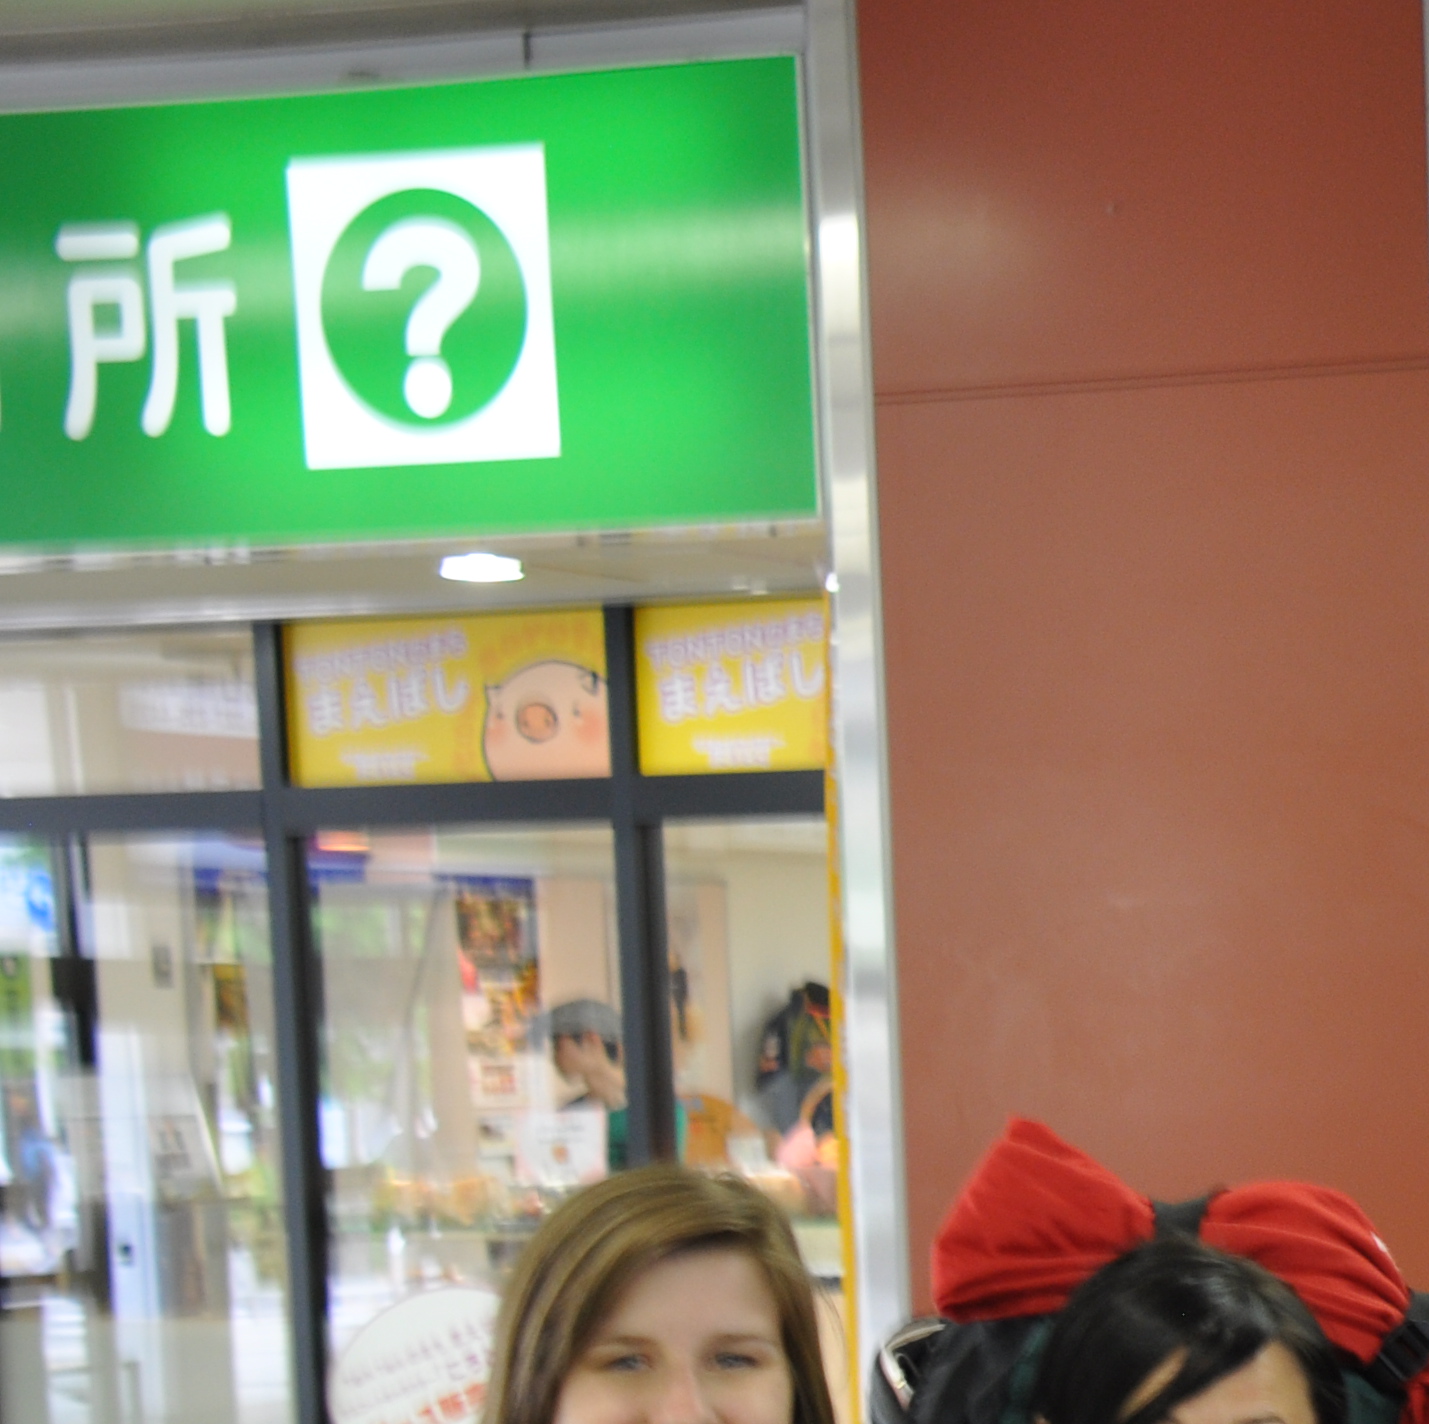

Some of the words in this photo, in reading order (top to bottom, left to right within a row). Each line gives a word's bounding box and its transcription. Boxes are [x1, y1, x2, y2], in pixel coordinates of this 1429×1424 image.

[56, 212, 237, 440] 所
[308, 668, 468, 739] まえばし
[660, 650, 825, 726] まえばし
